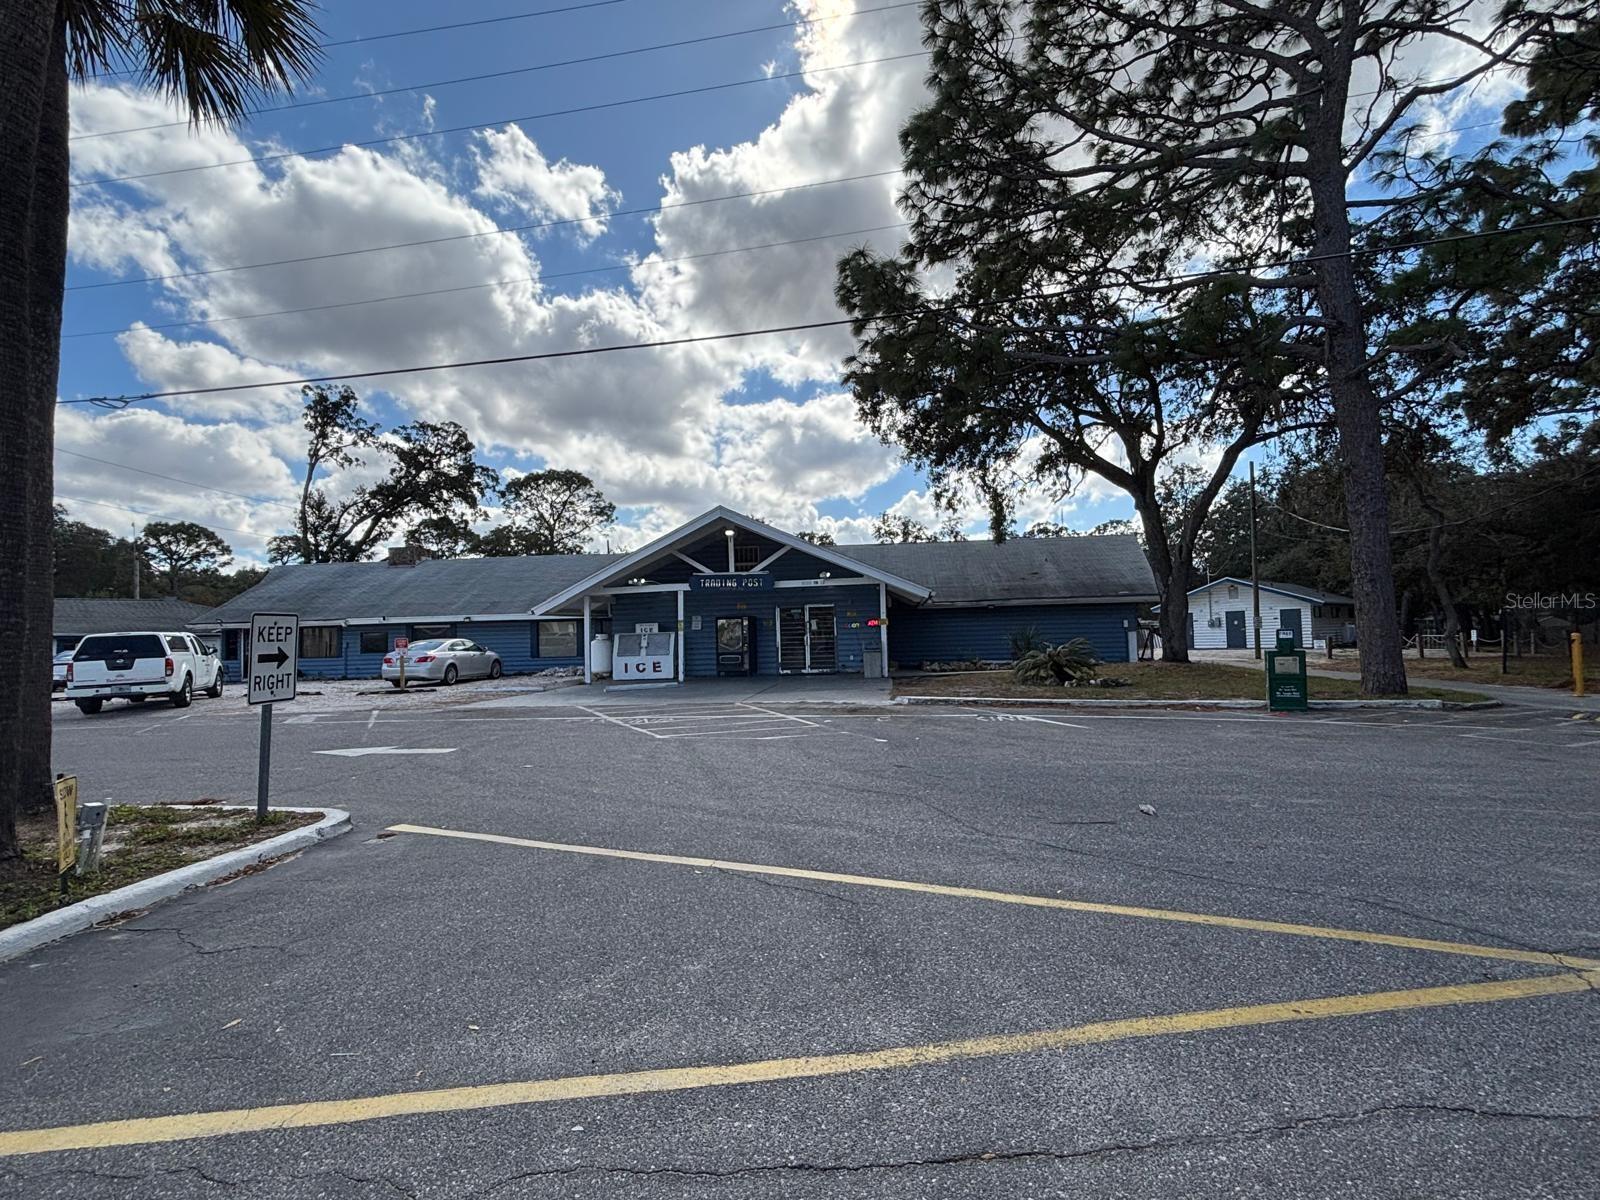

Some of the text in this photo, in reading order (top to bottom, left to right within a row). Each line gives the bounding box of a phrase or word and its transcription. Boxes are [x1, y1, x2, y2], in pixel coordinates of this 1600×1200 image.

[700, 579, 763, 587] TRADING POST
[257, 626, 293, 642] KEEP
[624, 661, 662, 674] ICE
[253, 673, 292, 692] RIGHT
